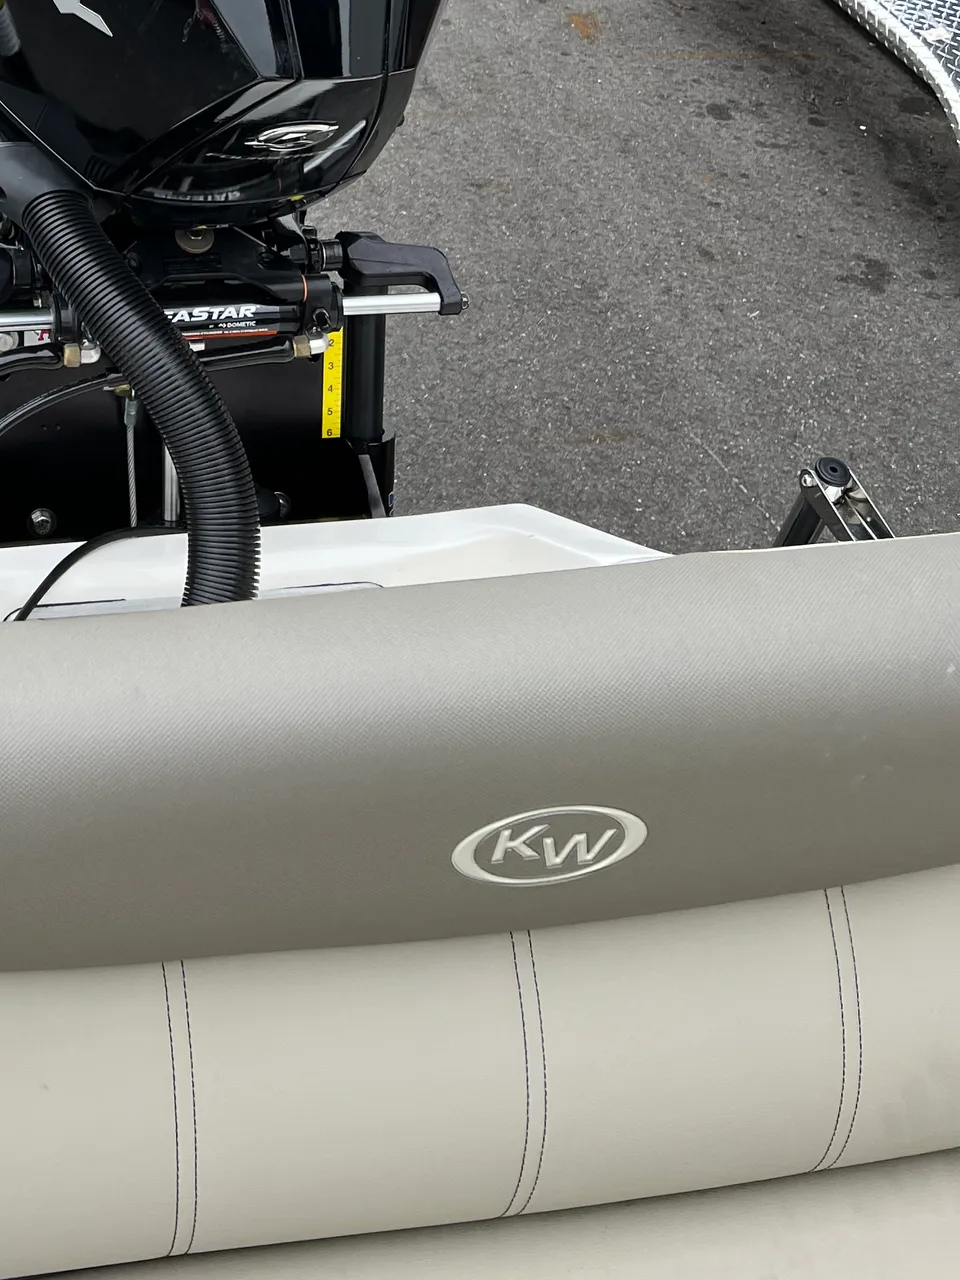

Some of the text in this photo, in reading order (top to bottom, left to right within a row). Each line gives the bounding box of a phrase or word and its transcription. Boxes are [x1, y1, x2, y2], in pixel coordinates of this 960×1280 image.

[328, 339, 335, 347] 2
[328, 362, 334, 370] 3
[327, 384, 333, 393] 4
[327, 407, 333, 416] 5
[326, 429, 333, 437] 6
[491, 824, 617, 868] KW
